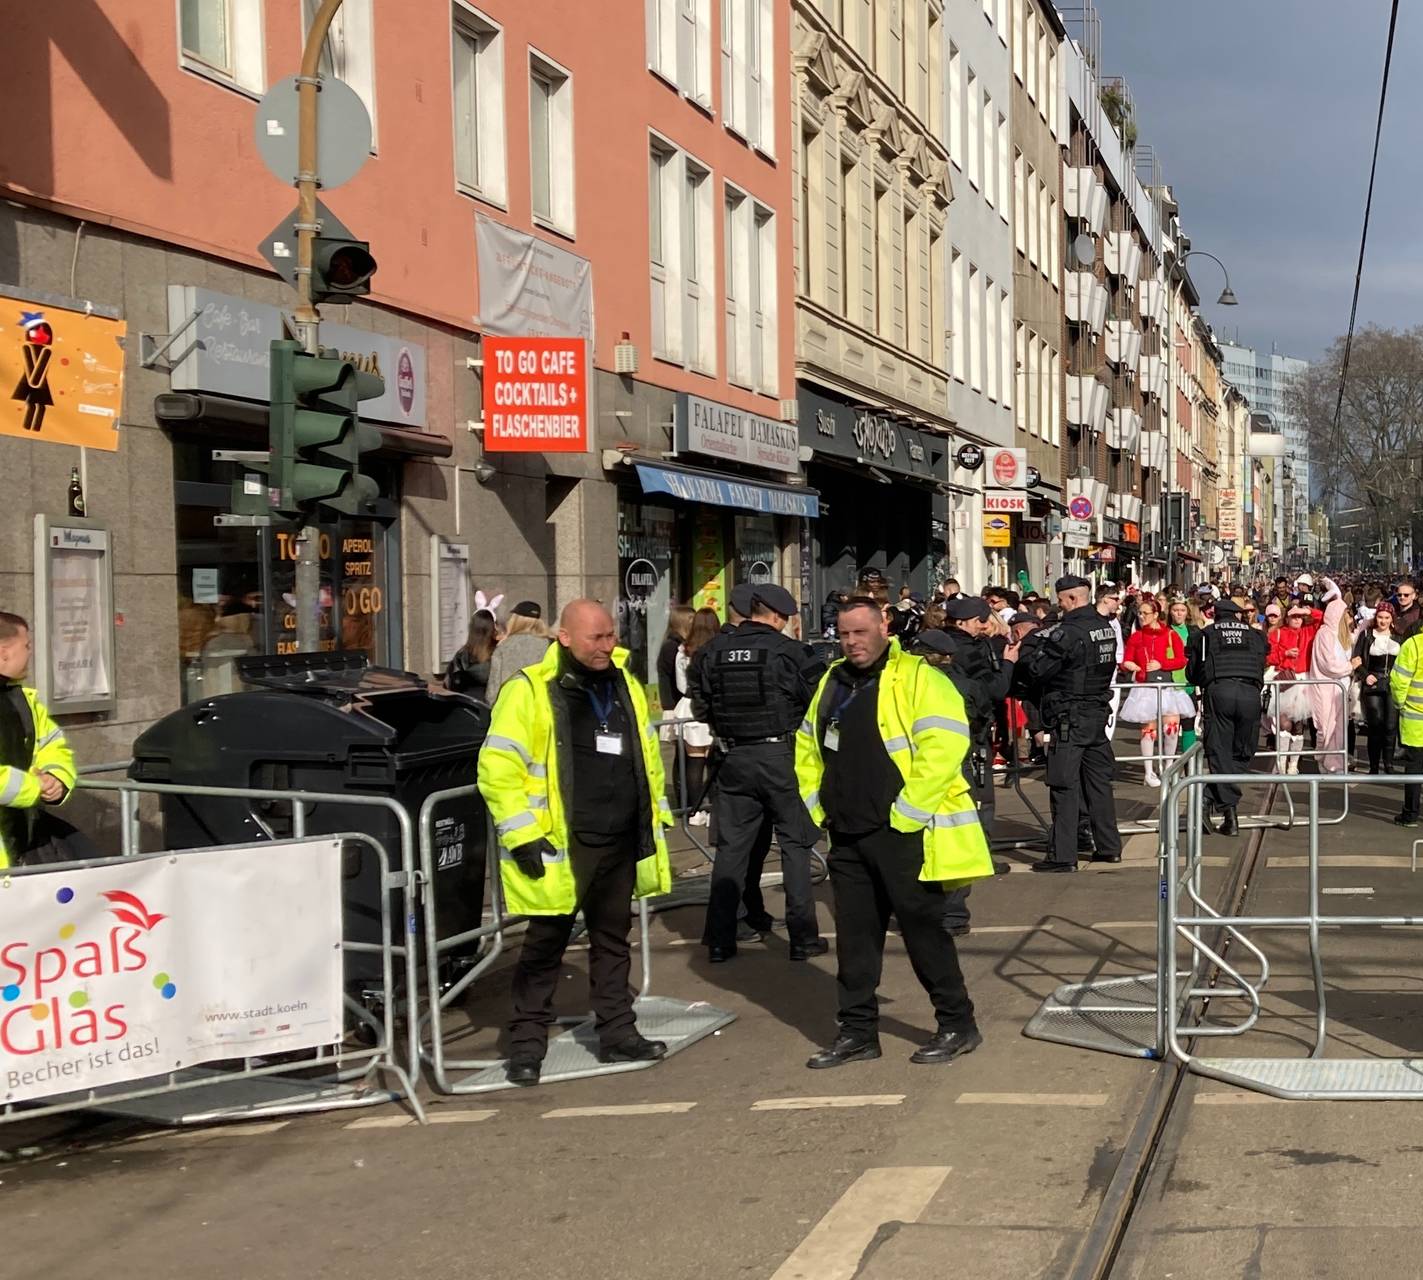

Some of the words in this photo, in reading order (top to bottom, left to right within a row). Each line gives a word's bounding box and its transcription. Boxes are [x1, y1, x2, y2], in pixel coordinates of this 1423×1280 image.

[495, 350, 513, 374] TO
[518, 350, 537, 374] GO
[541, 351, 576, 375] CAFE
[492, 414, 580, 439] FLASCHENBIER
[694, 403, 744, 438] FALAFEL
[750, 418, 797, 452] DAMASKUS
[815, 408, 836, 437] Sushi
[987, 498, 1025, 509] KIOSK
[343, 538, 374, 554] APEROL
[344, 561, 373, 577] SPRITZ
[359, 587, 382, 614] GO
[1214, 621, 1250, 630] POLIZEI
[728, 650, 751, 662] 3T3
[0, 926, 148, 1000] Spaß
[204, 1000, 308, 1023] www.stadt.koeln
[0, 996, 128, 1056] Glas
[7, 1059, 85, 1089] Becher
[88, 1050, 113, 1069] ist
[117, 1037, 161, 1062] das!
